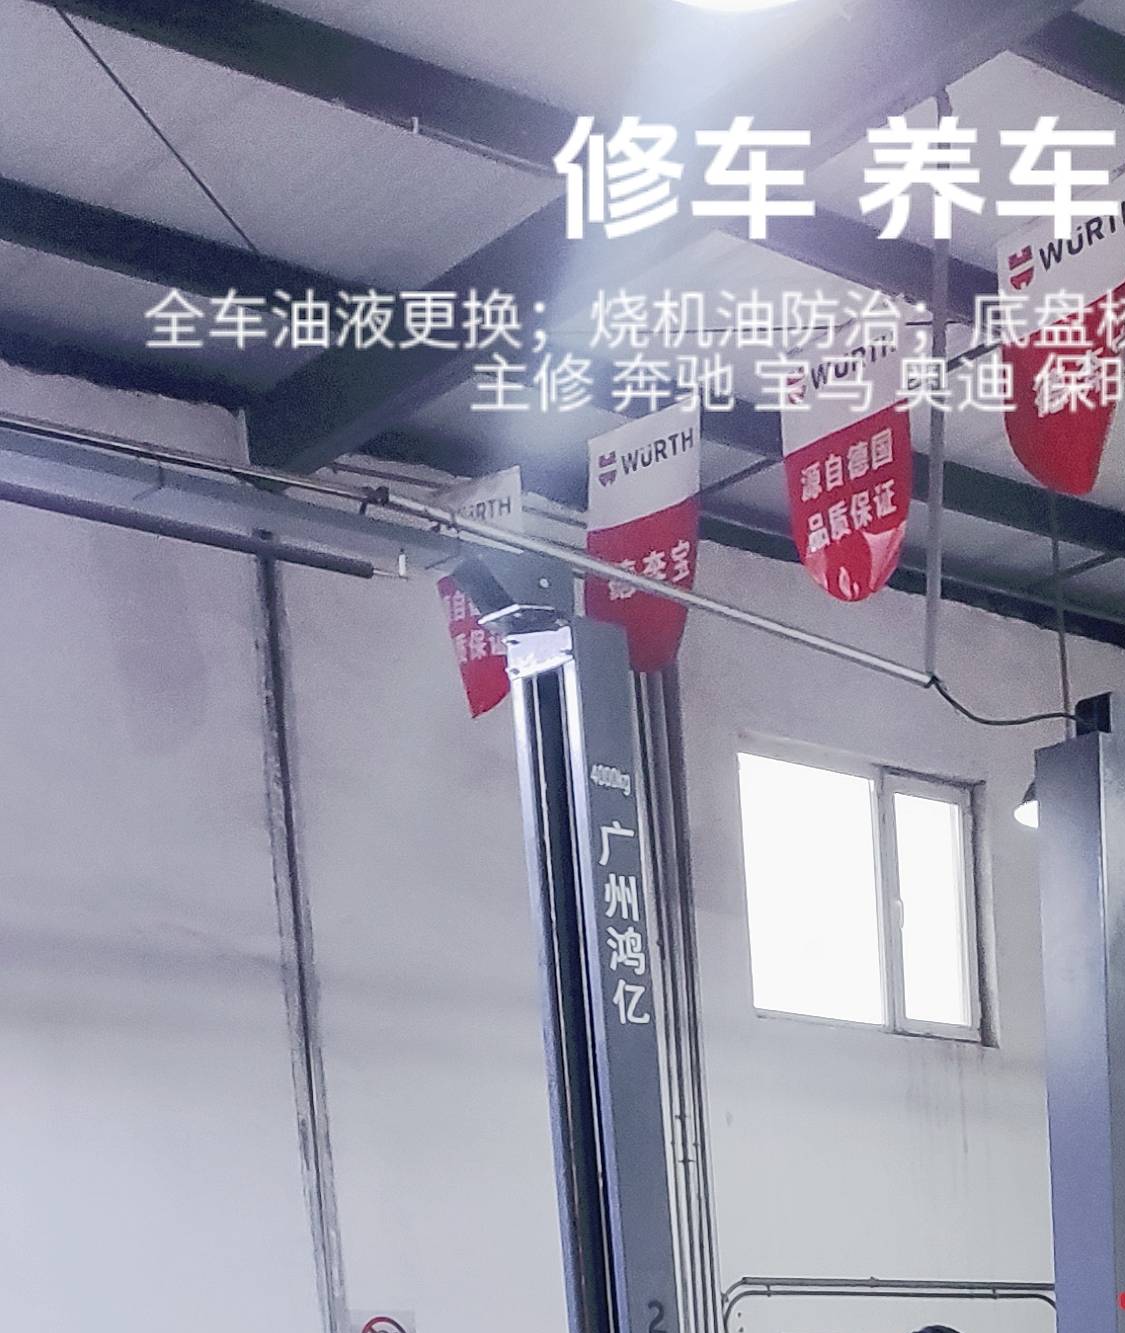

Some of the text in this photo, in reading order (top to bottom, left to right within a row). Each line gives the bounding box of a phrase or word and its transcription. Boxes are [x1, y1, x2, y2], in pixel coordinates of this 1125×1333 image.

[801, 428, 893, 502] 源自德国
[807, 480, 898, 552] 品质保证
[599, 820, 650, 1025] 广州鸿亿
